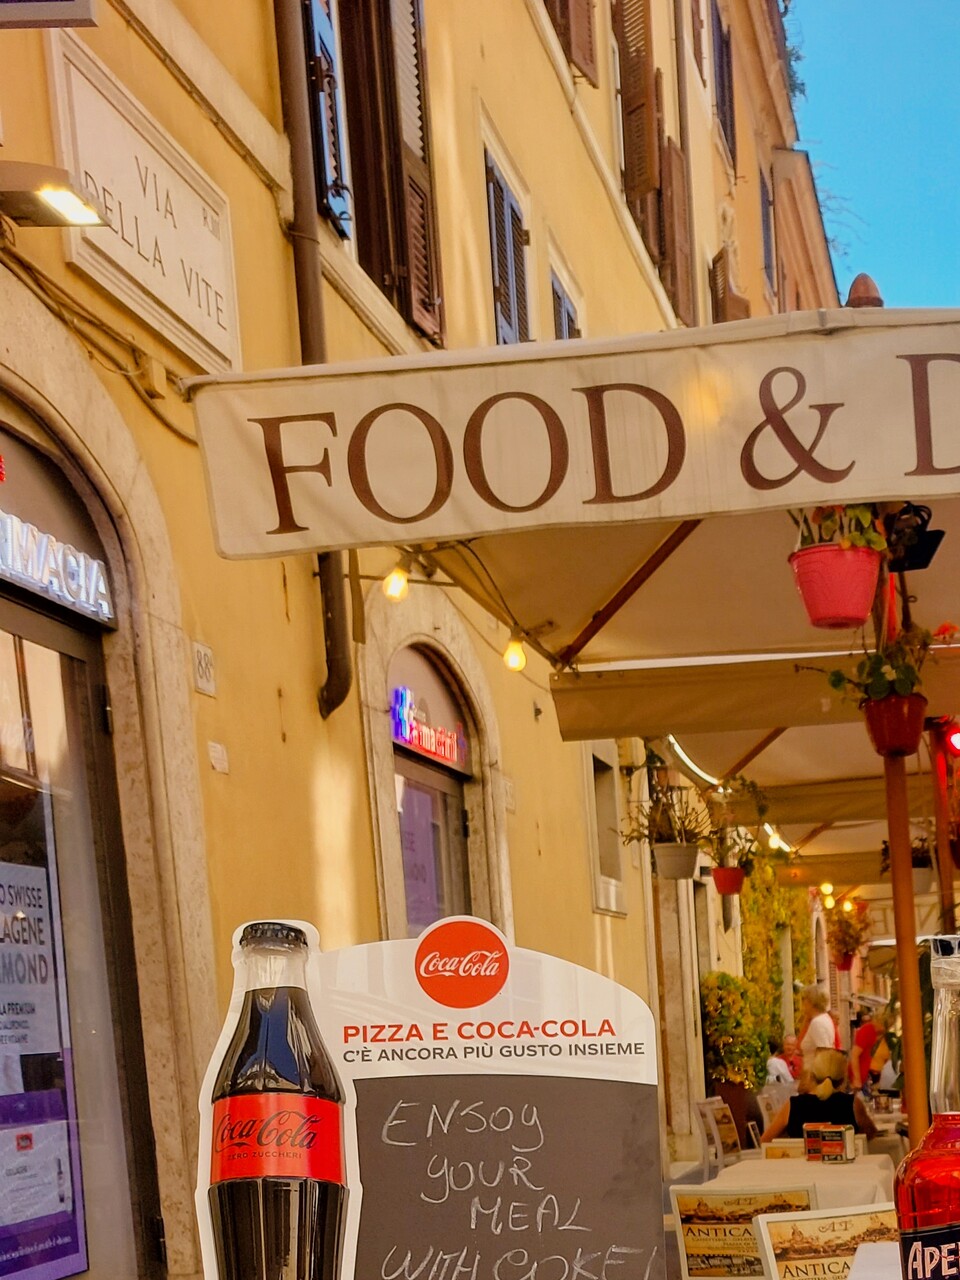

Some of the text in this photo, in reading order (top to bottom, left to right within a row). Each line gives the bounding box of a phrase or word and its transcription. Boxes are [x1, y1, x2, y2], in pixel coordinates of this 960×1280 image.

[134, 154, 178, 230] VIA
[84, 170, 228, 332] DELLA VITE
[246, 382, 688, 537] FOOD
[740, 365, 856, 491] &
[0, 511, 114, 622] MACIA
[8, 884, 43, 908] SWISSE
[419, 950, 505, 979] Coca-Cola
[343, 1019, 616, 1044] PIZZA E COCA-COLA
[377, 1046, 458, 1062] ANCORA
[463, 1042, 493, 1058] PIÙ
[499, 1044, 563, 1058] GUSTO
[568, 1042, 645, 1056] INSIEME
[215, 1110, 322, 1152] Coca-Cola
[470, 1194, 592, 1234] MEAL
[686, 1226, 752, 1237] ANTICA
[783, 1261, 851, 1279] ANTICA
